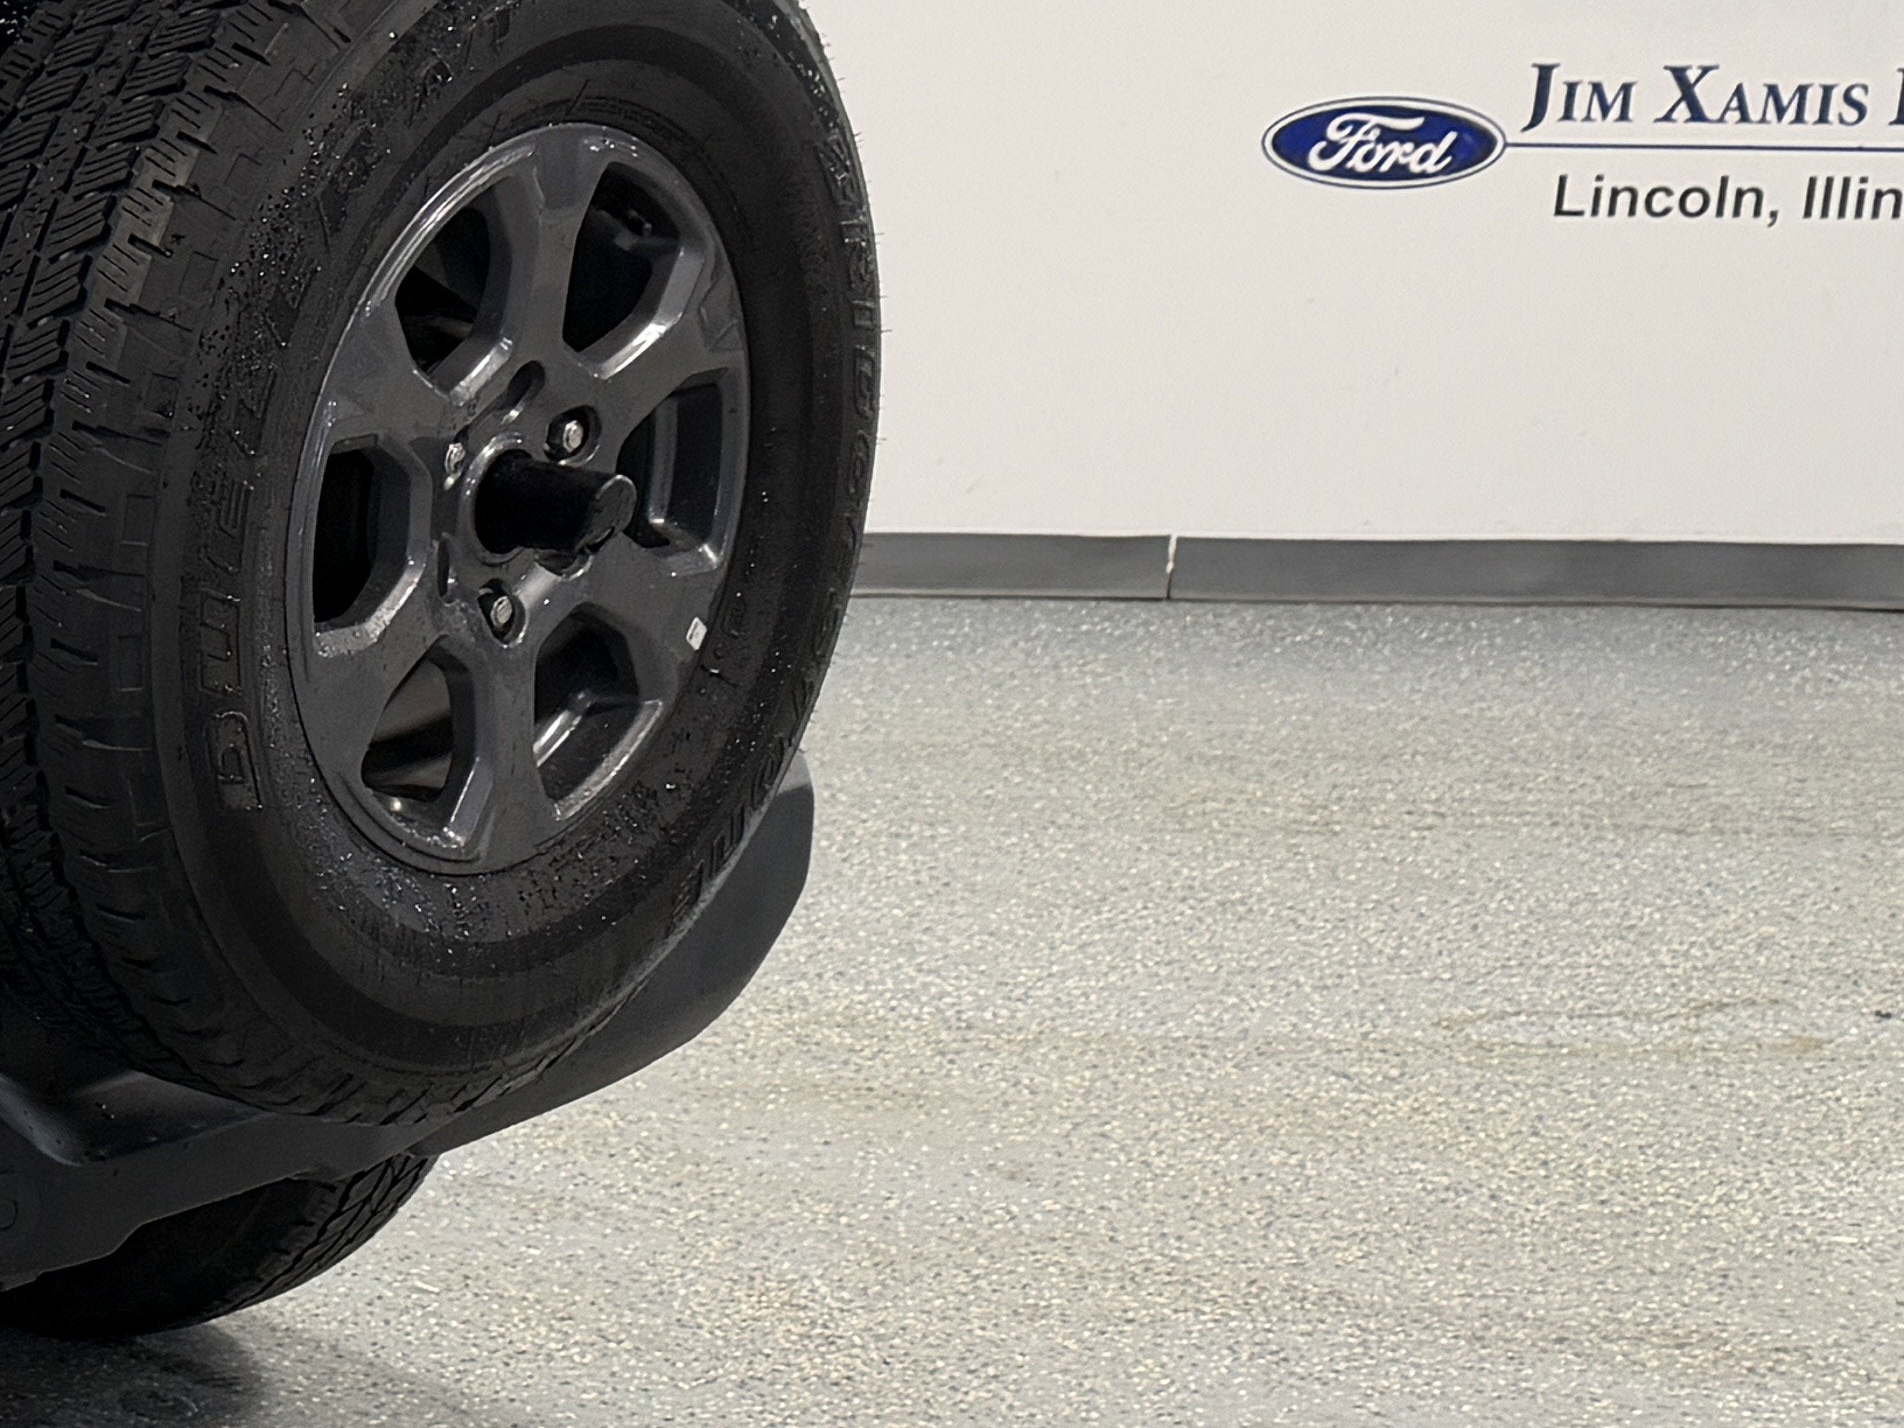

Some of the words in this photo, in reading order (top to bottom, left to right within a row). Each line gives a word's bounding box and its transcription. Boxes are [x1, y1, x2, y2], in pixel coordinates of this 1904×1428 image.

[1521, 62, 1637, 132] JIM
[1654, 63, 1869, 126] XAMIS
[1308, 112, 1452, 173] Ford
[1553, 175, 1778, 227] Lincoln,
